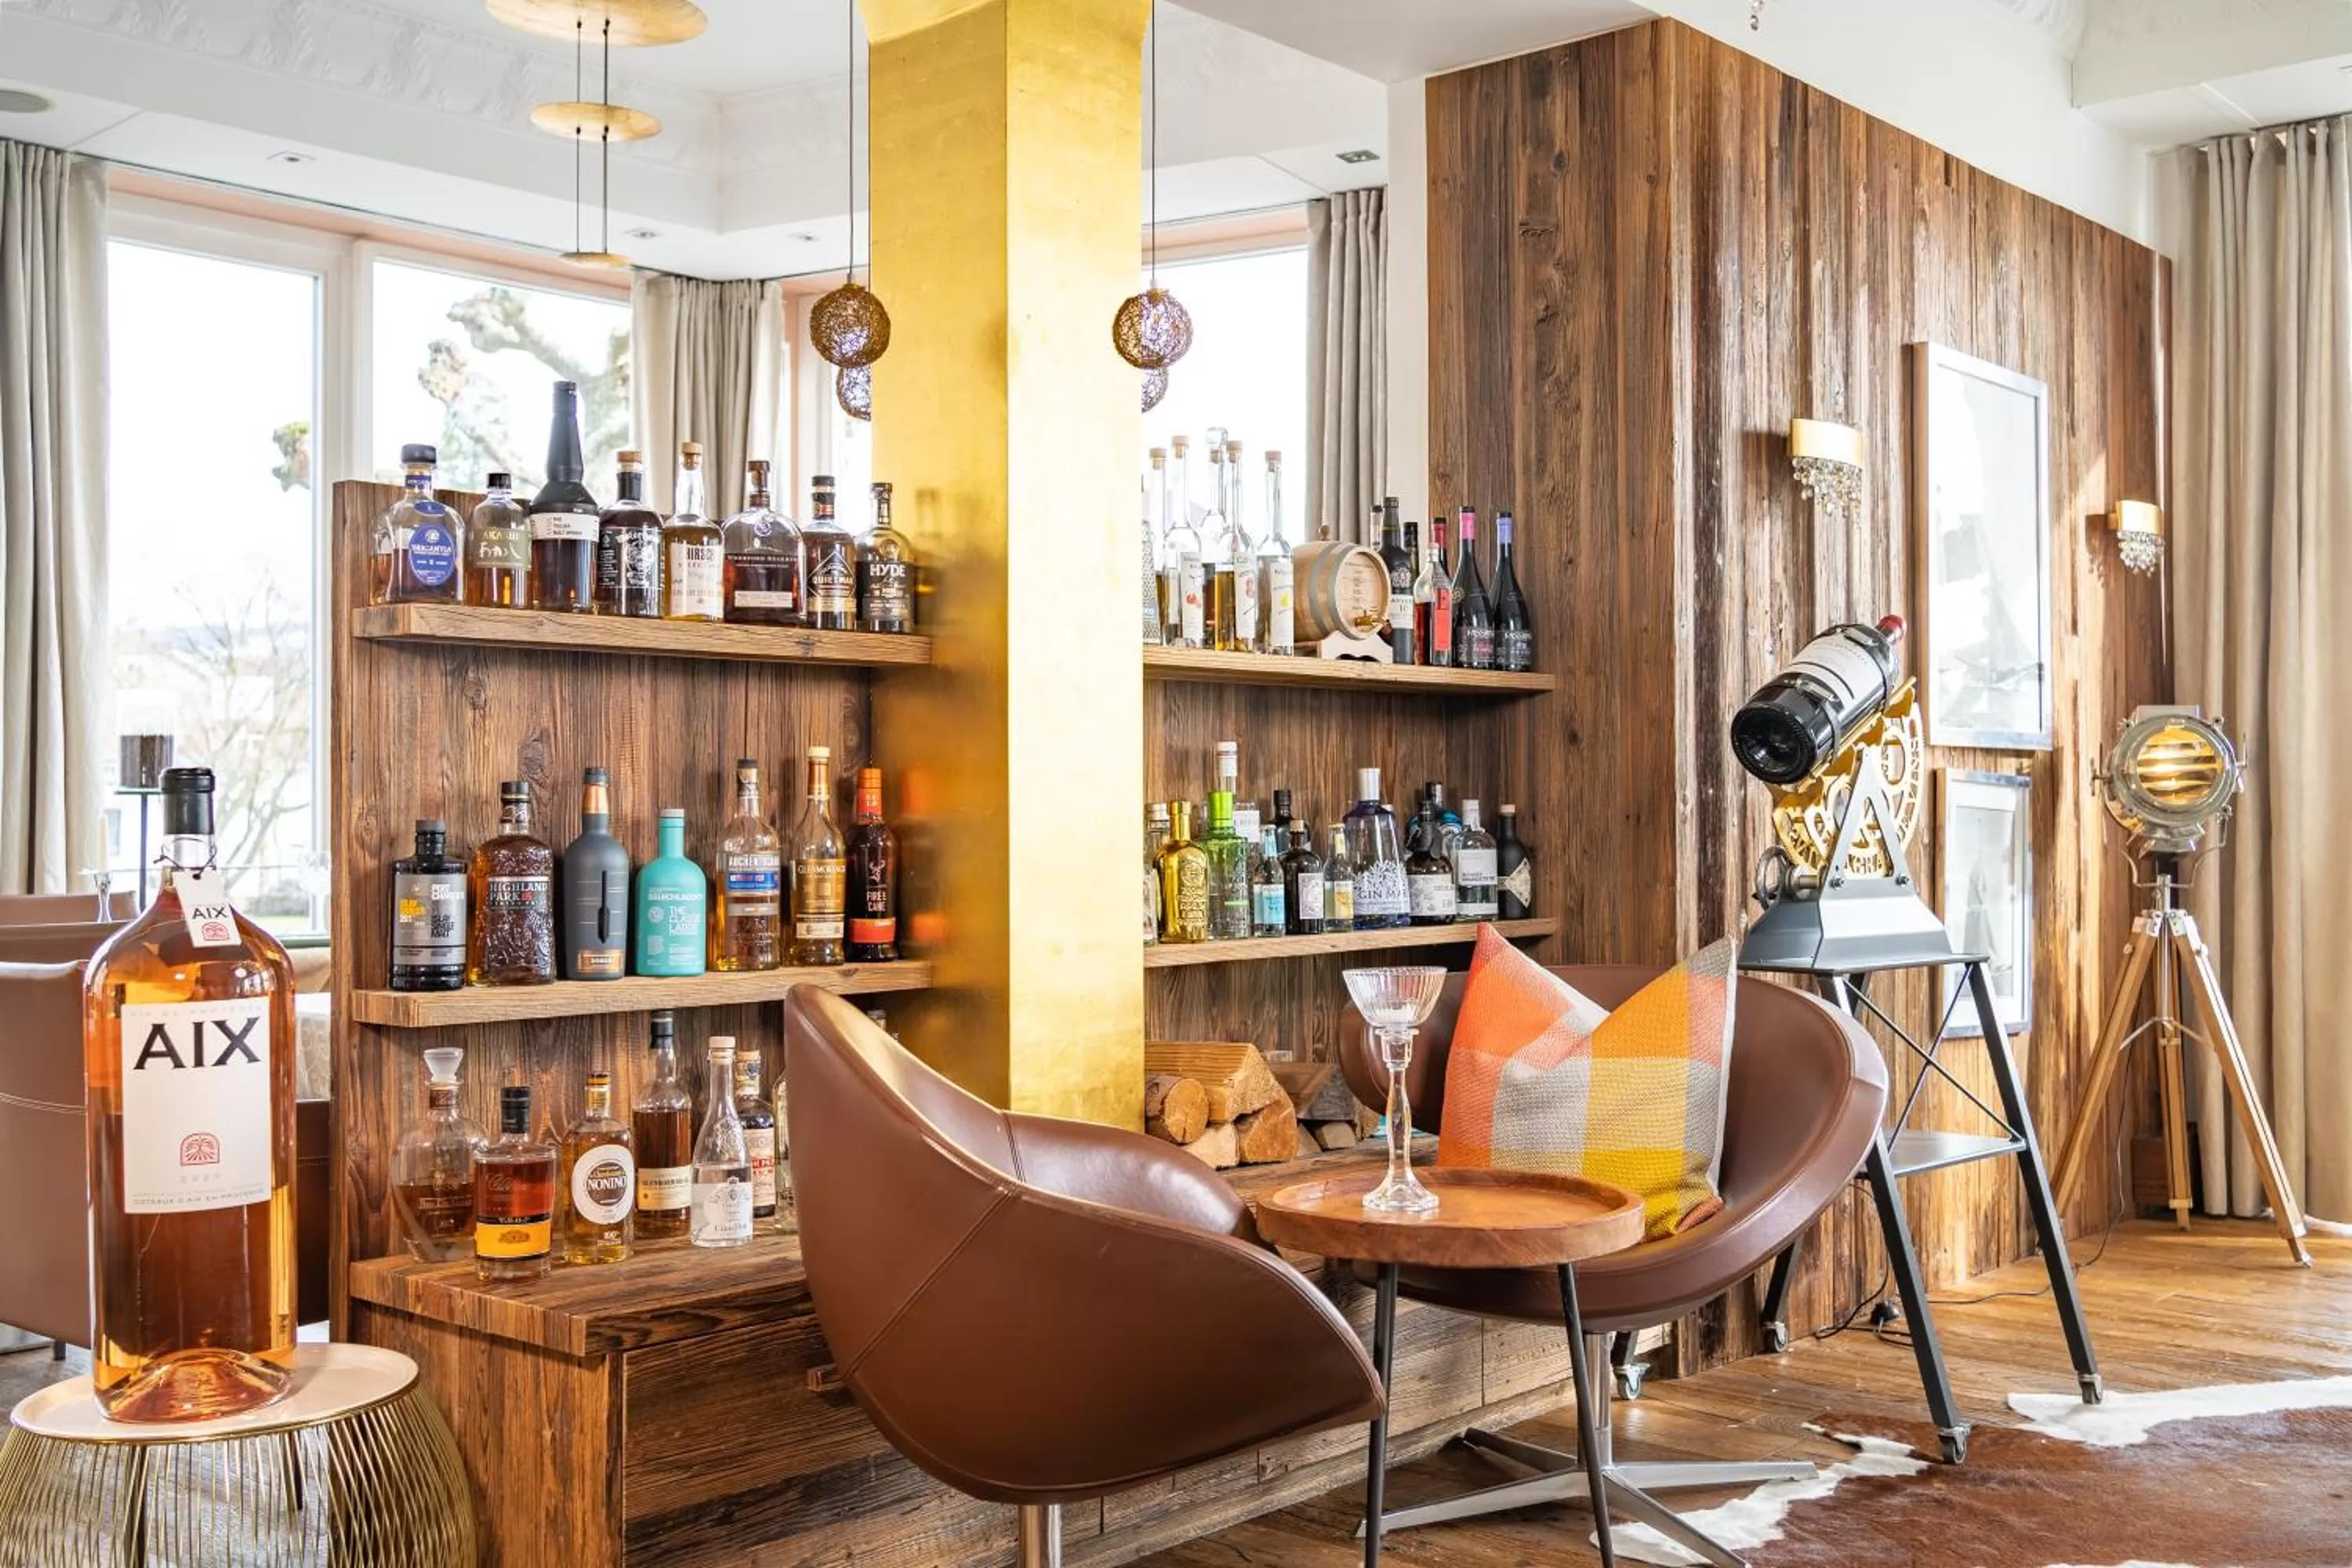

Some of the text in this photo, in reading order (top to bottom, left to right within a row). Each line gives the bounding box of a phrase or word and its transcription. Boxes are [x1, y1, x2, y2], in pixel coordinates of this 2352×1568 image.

[869, 564, 906, 577] HYDE
[490, 882, 547, 891] HIGHLAND
[490, 891, 519, 901] PARK
[1358, 890, 1382, 900] GIN
[193, 906, 228, 920] AIX
[133, 1017, 260, 1070] AIX
[588, 1176, 626, 1190] NONINO
